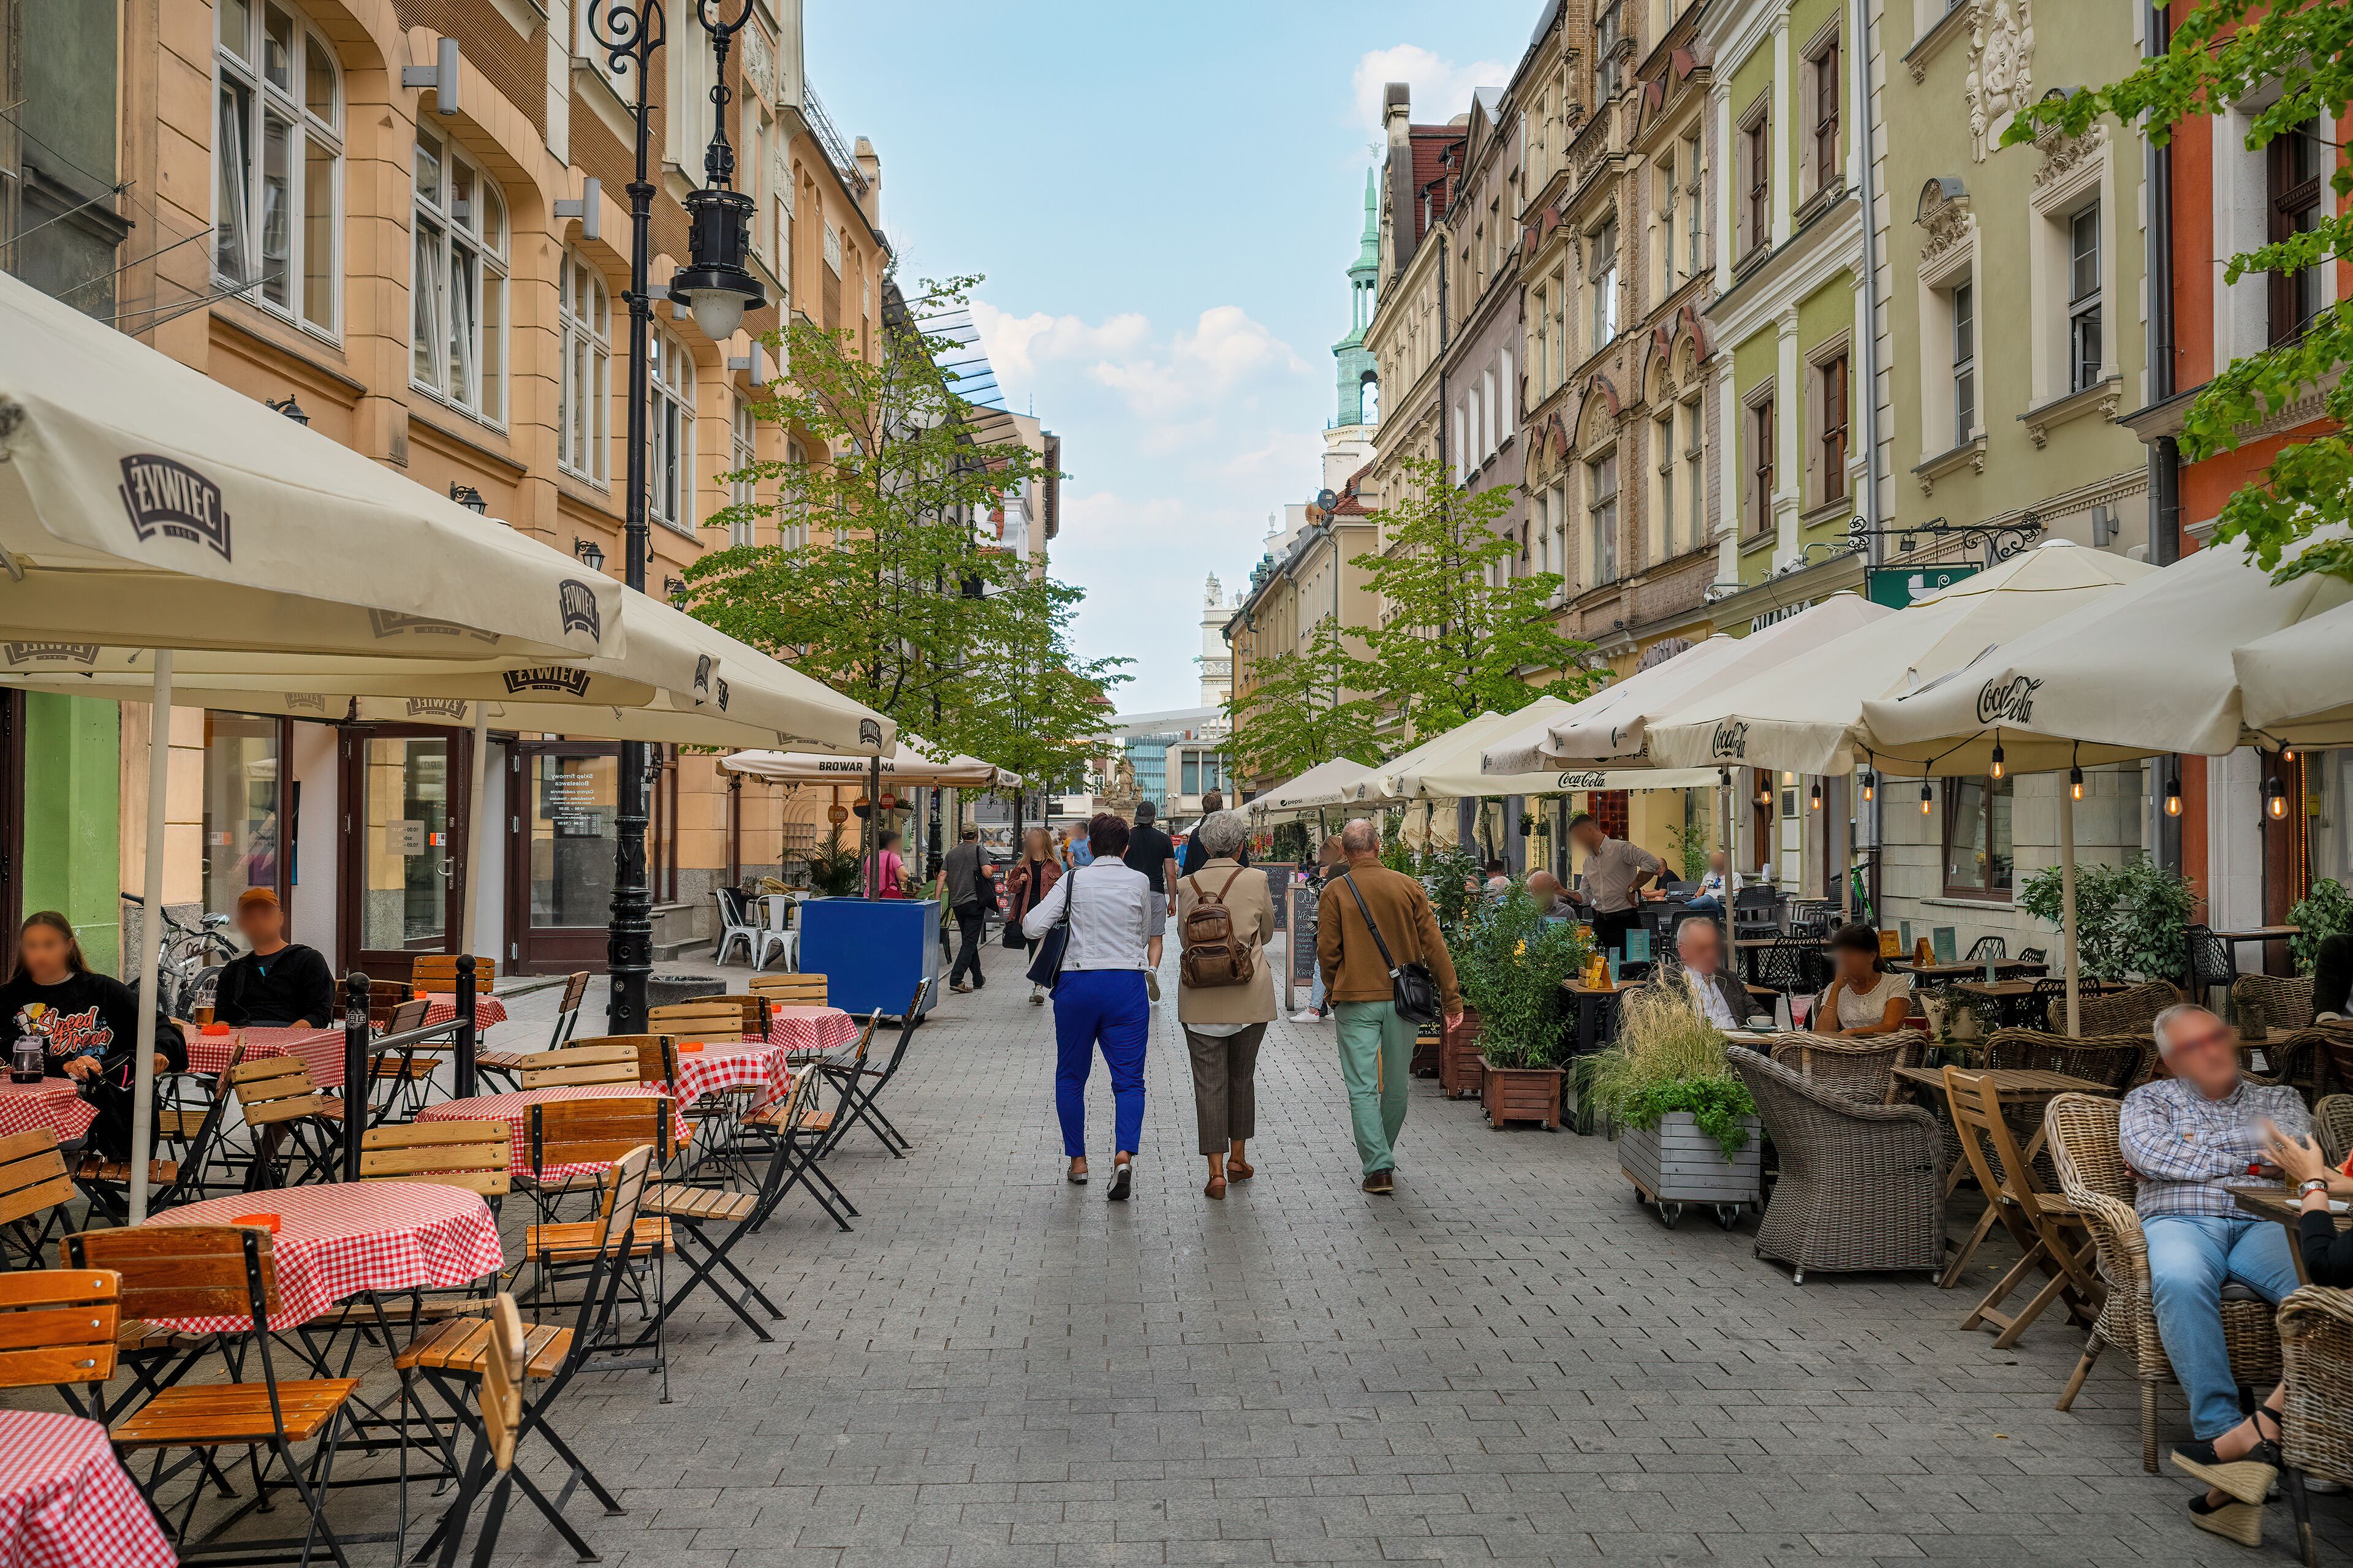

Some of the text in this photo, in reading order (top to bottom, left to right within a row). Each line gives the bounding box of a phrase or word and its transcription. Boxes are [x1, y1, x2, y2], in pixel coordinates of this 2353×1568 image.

[130, 457, 216, 531] ŻYWIEC
[563, 583, 594, 624] ŻYWIEC
[819, 762, 863, 771] BROWAR
[1558, 770, 1608, 789] Coca-Cola
[1297, 968, 1314, 977] KRAF
